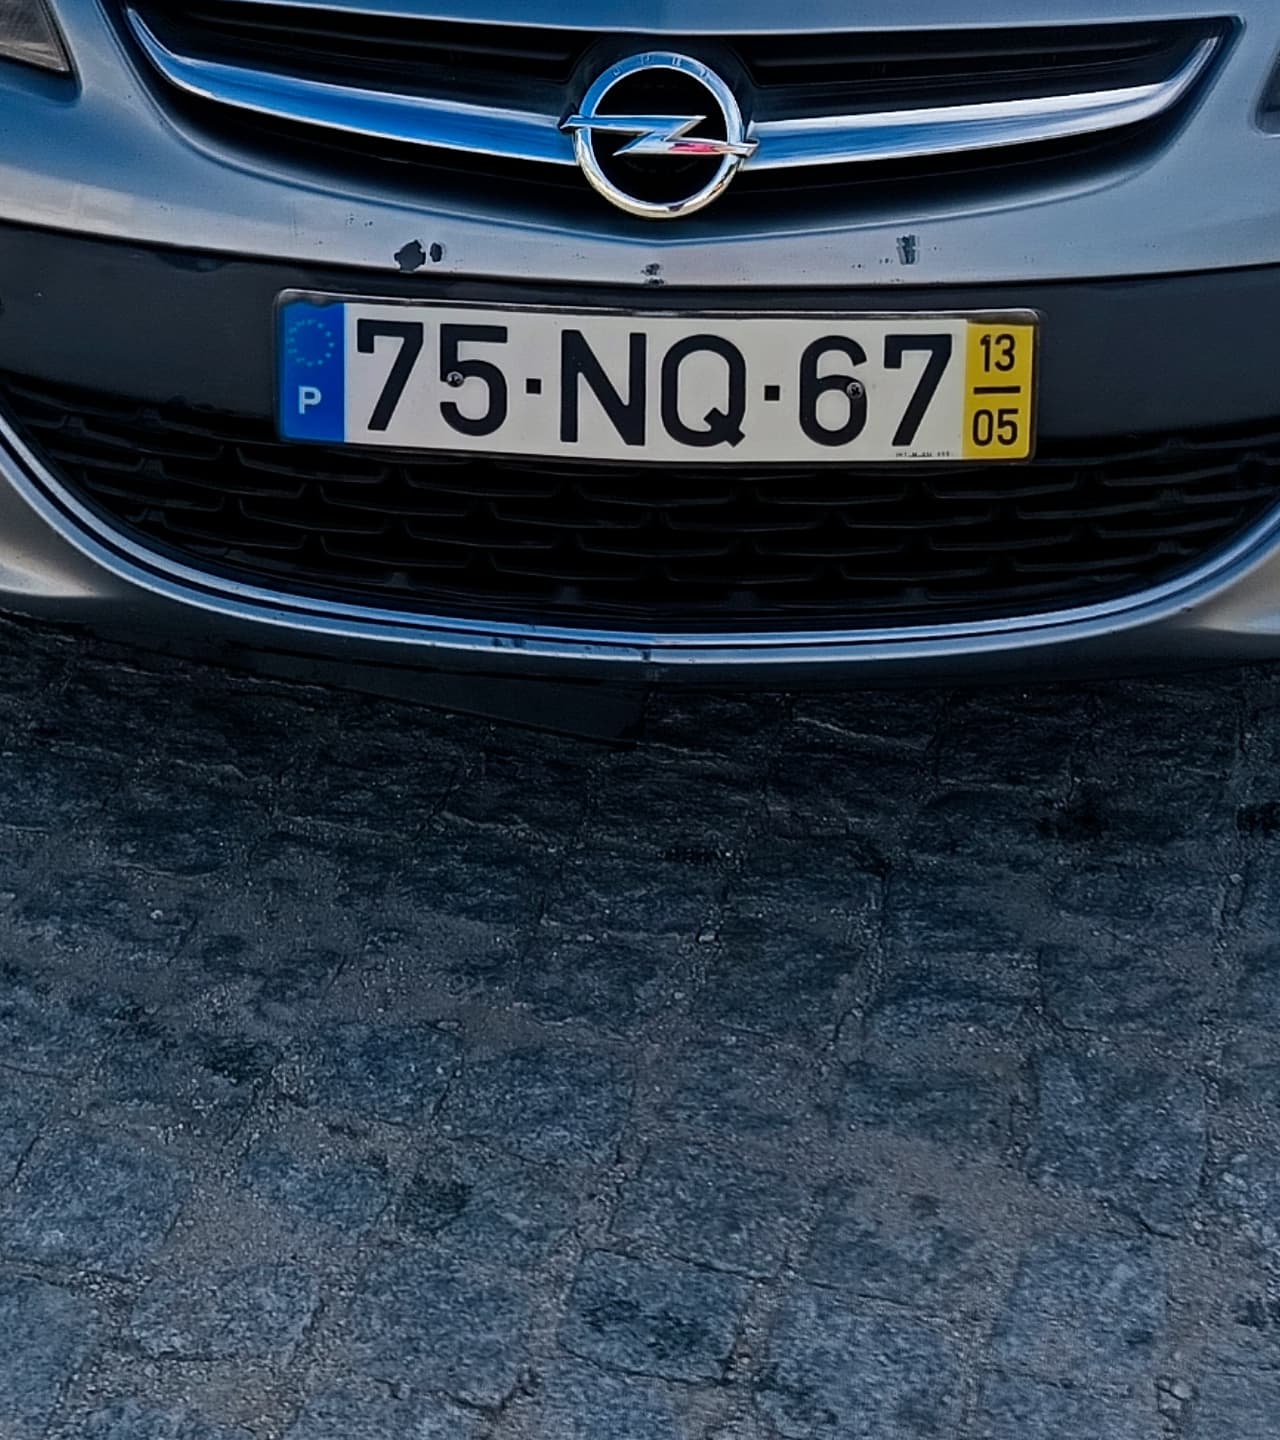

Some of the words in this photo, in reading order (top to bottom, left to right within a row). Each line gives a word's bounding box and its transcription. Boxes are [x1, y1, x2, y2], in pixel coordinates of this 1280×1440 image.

[979, 333, 1016, 372] 13
[298, 386, 322, 415] P
[972, 409, 1019, 446] 05
